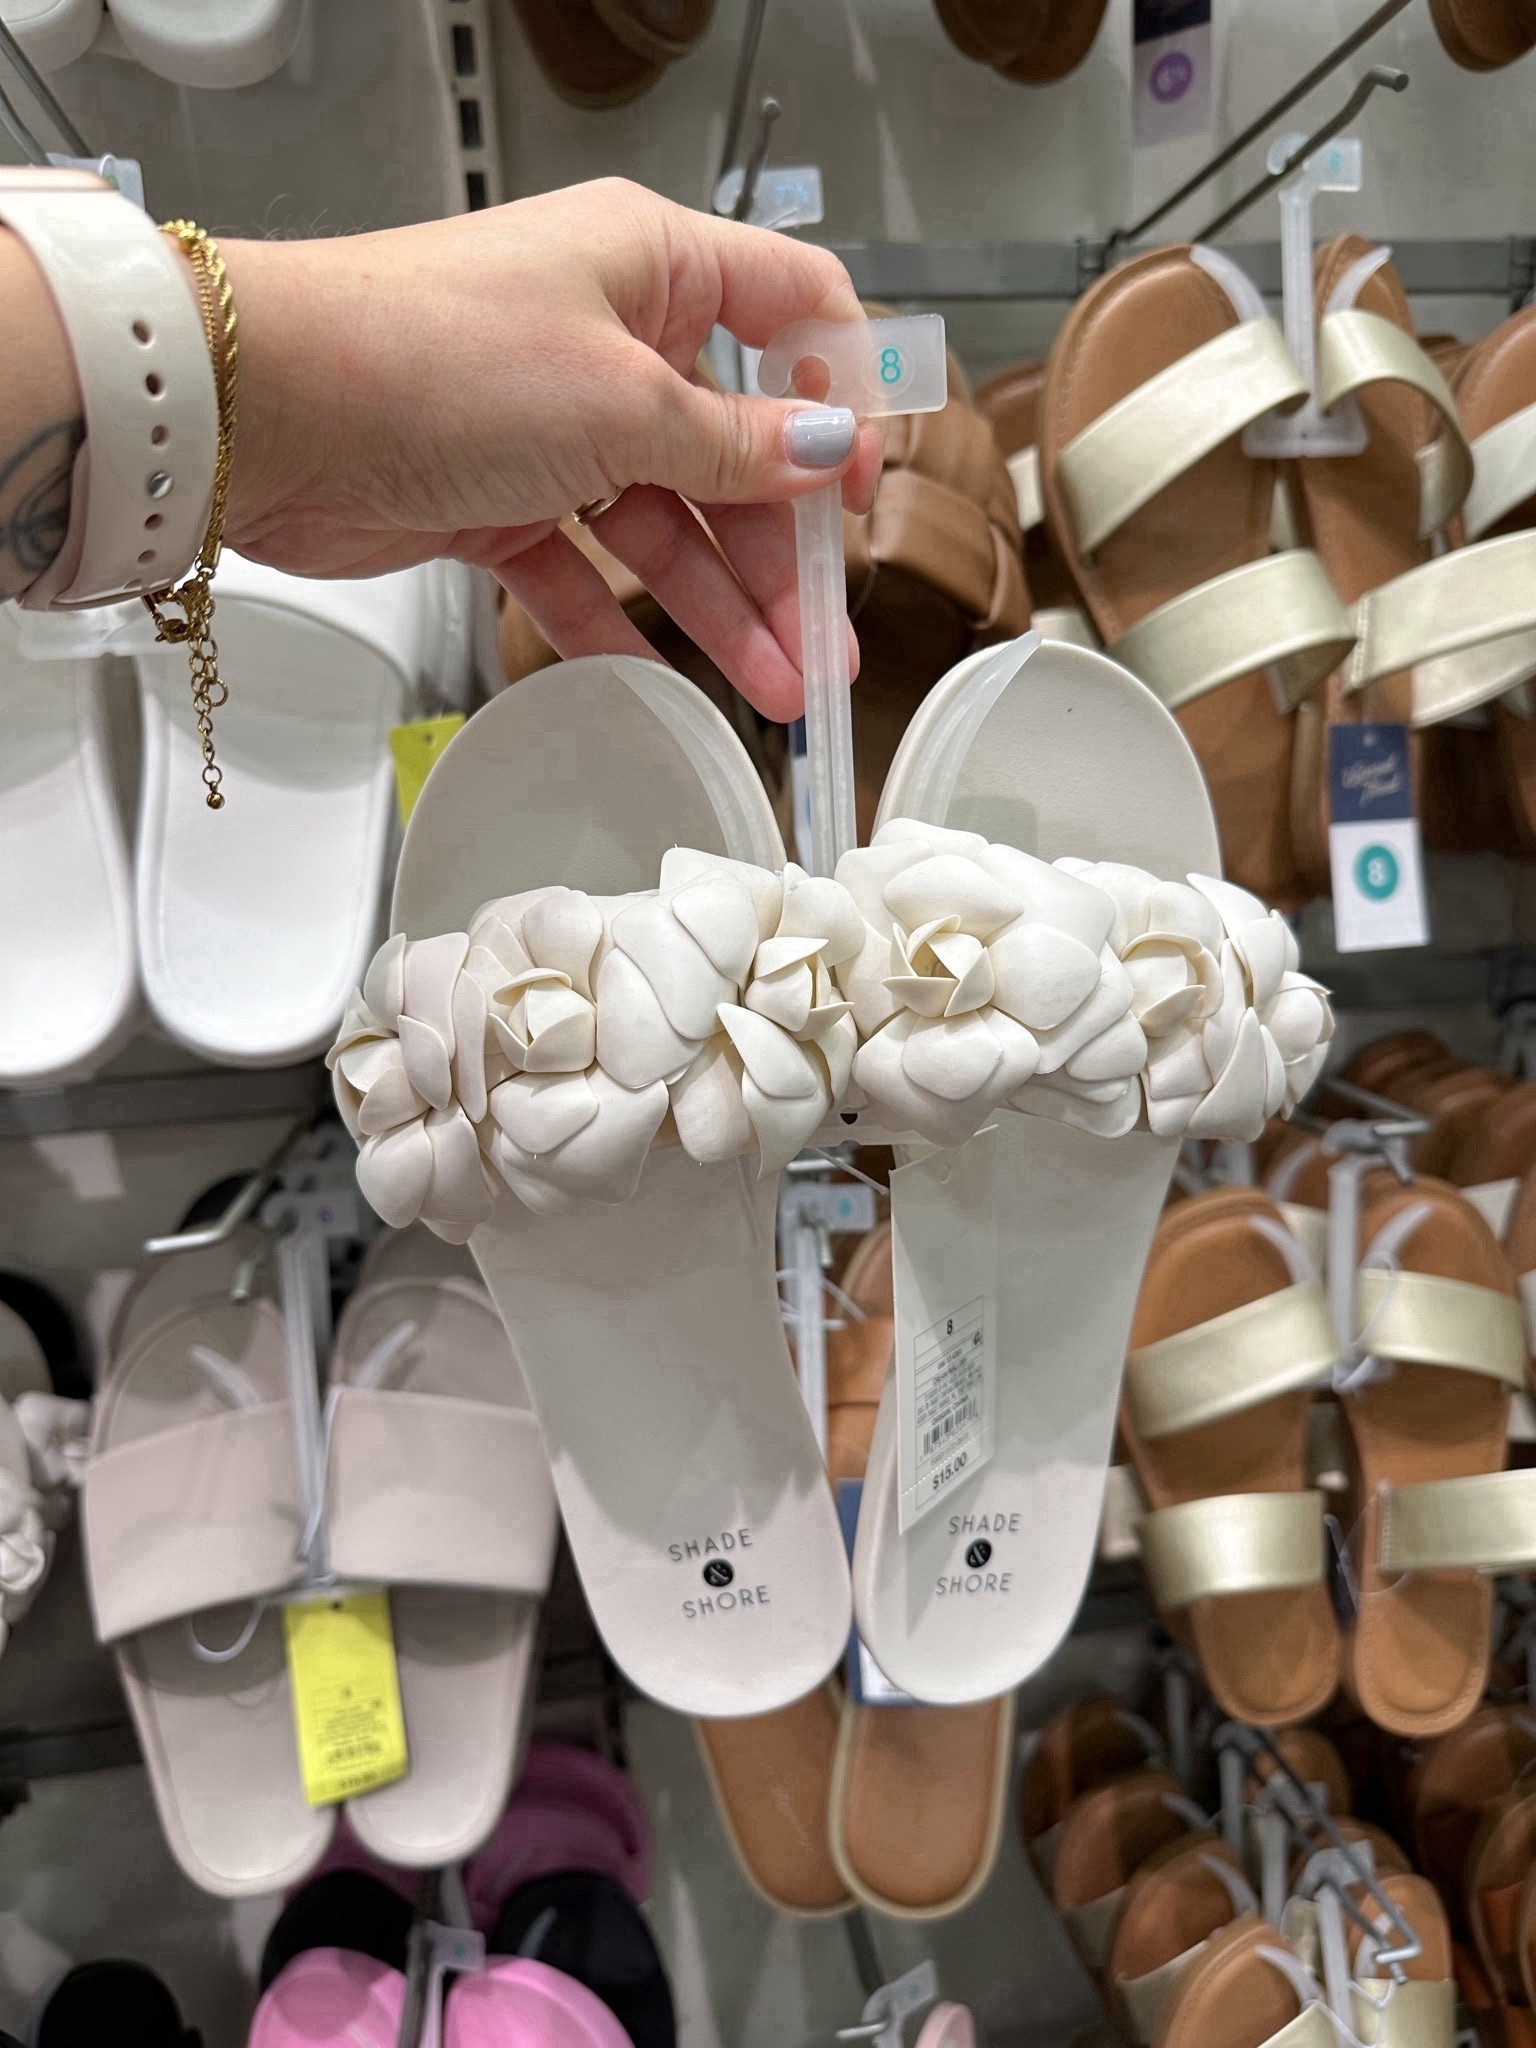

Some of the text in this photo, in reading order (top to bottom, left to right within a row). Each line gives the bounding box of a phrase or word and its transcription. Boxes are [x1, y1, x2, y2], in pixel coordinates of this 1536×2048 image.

[880, 347, 901, 384] 8
[1367, 856, 1388, 888] 8
[946, 1319, 953, 1335] 8
[933, 1452, 967, 1490] $15.00
[949, 1513, 1021, 1534] SHADE
[669, 1529, 754, 1562] SHADE
[936, 1573, 1012, 1596] SHORE
[682, 1585, 770, 1619] SHORE
